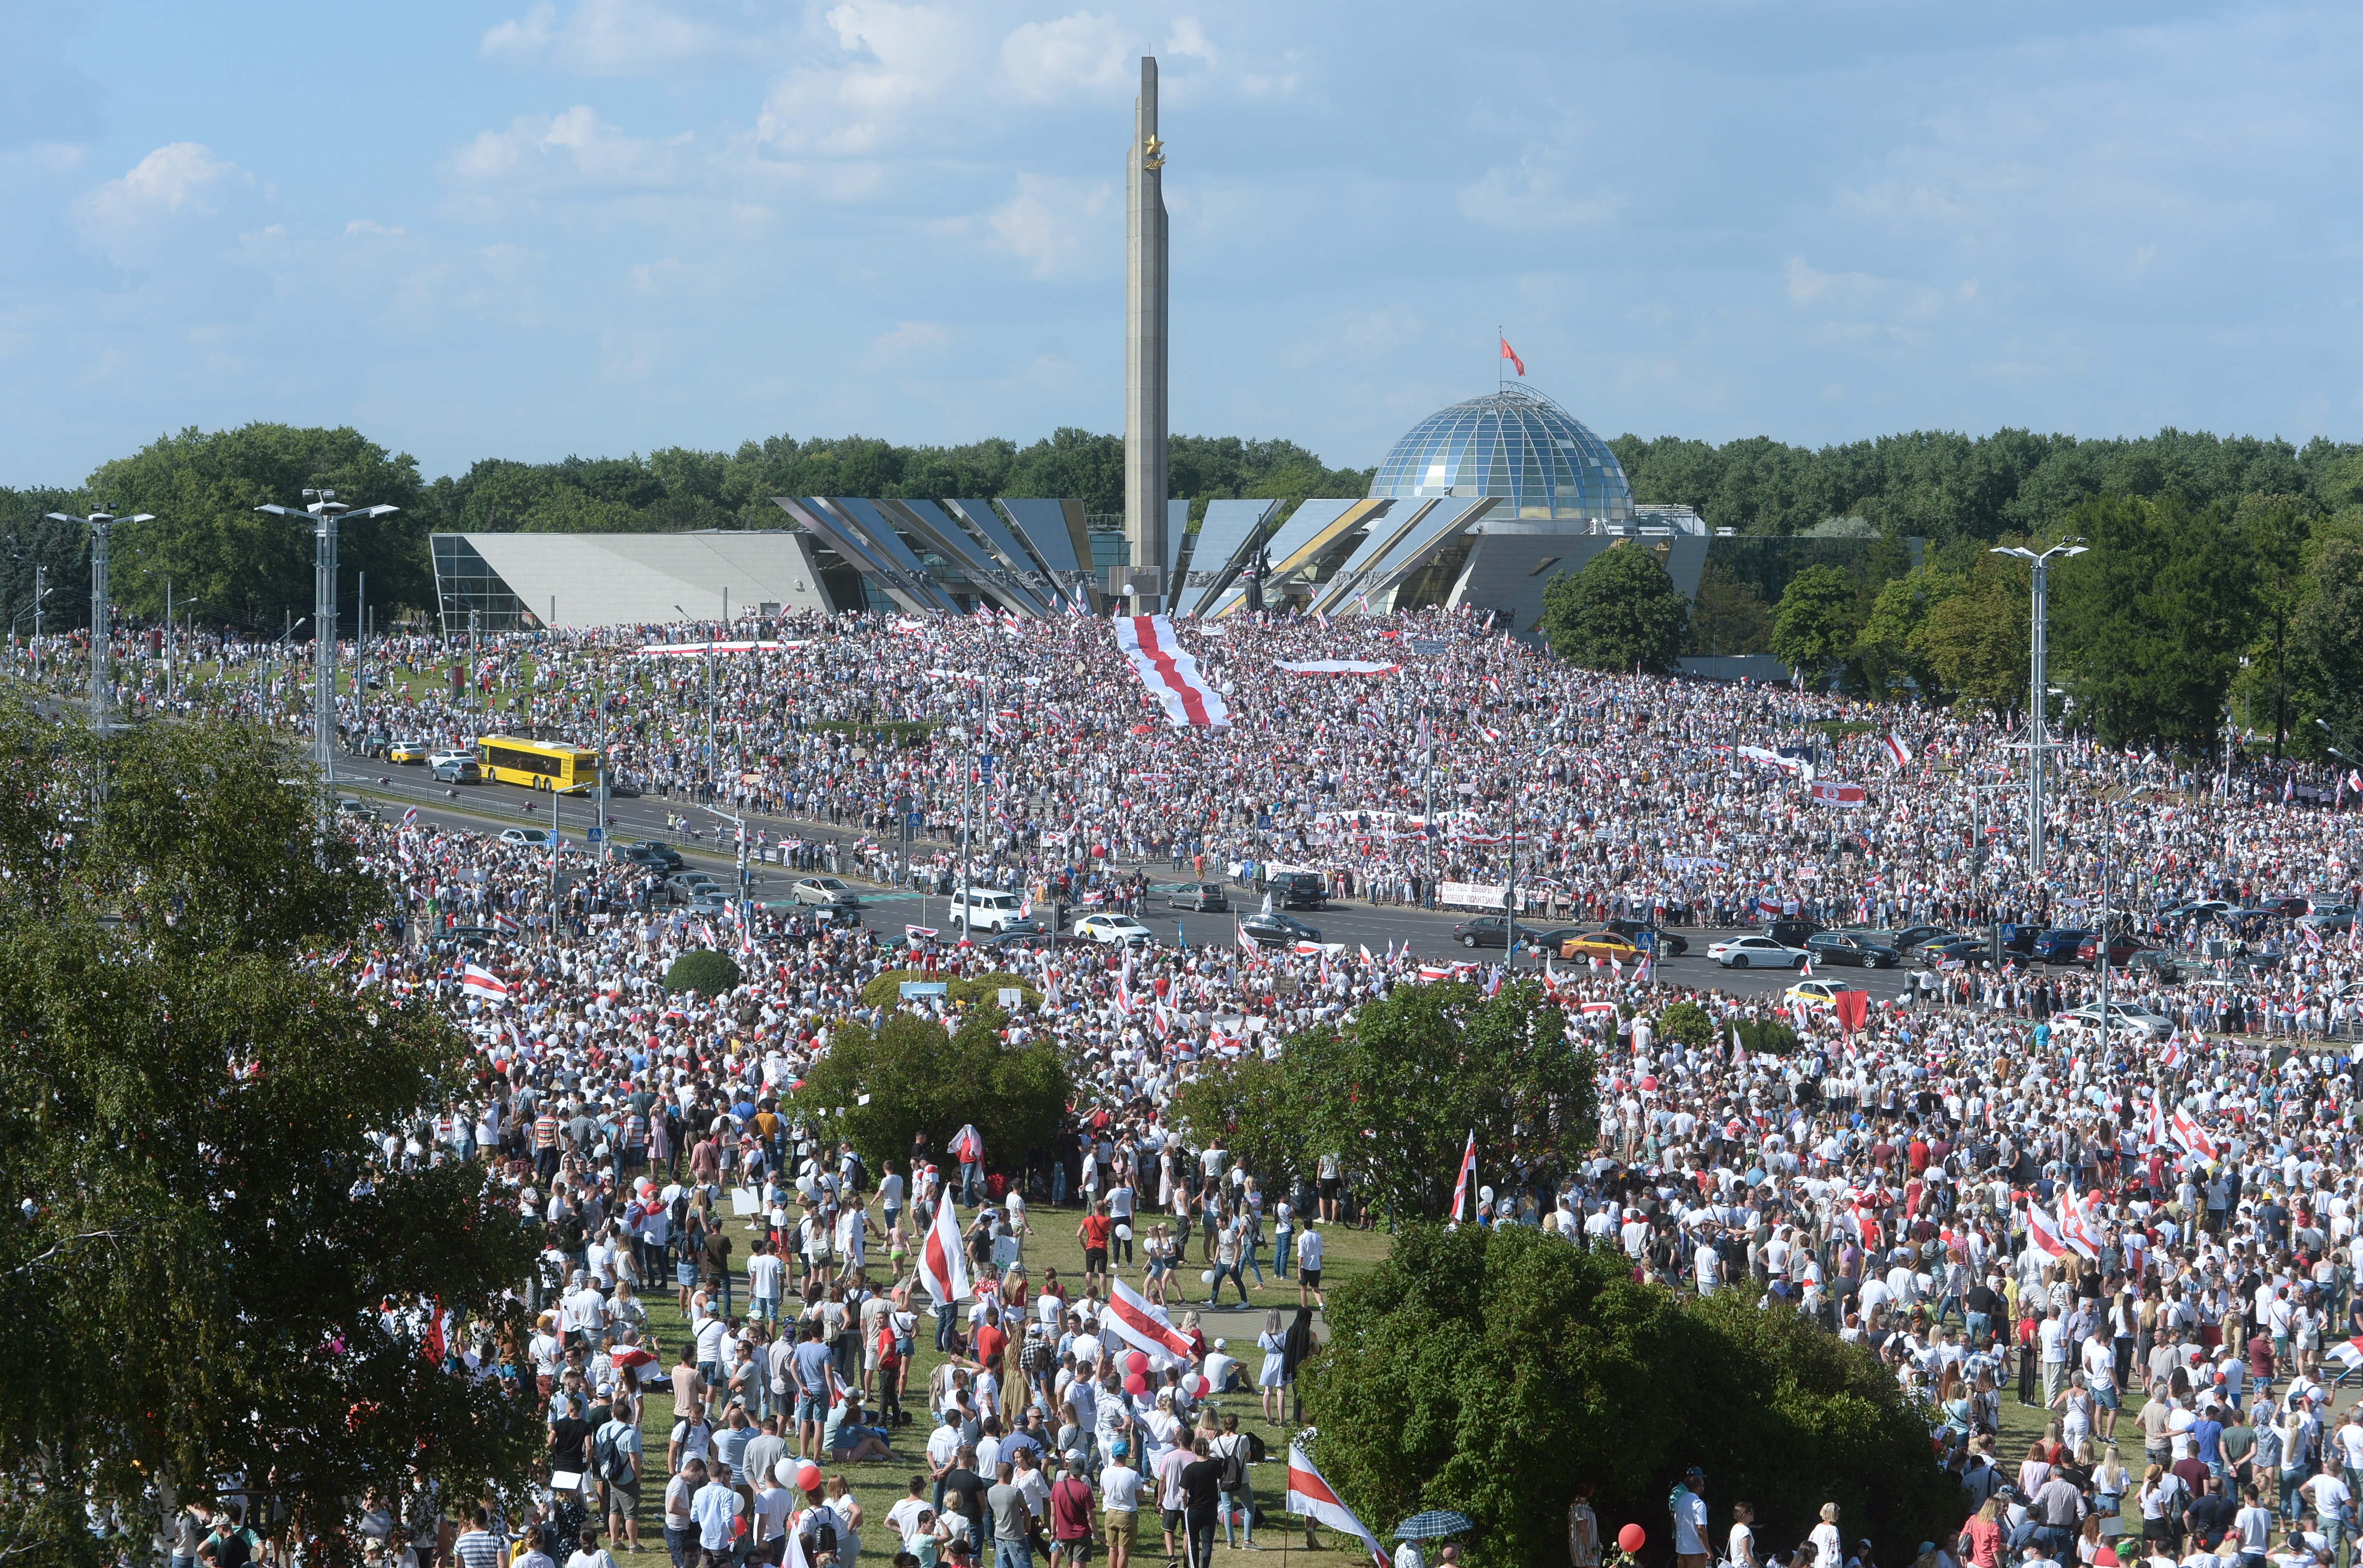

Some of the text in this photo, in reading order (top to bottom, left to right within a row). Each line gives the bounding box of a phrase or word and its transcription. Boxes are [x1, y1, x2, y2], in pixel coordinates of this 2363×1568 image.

[1444, 882, 1468, 892] ЧЕСТНЫЕ
[1443, 894, 1464, 902] СВОБОДУ
[764, 1060, 786, 1072] САША,
